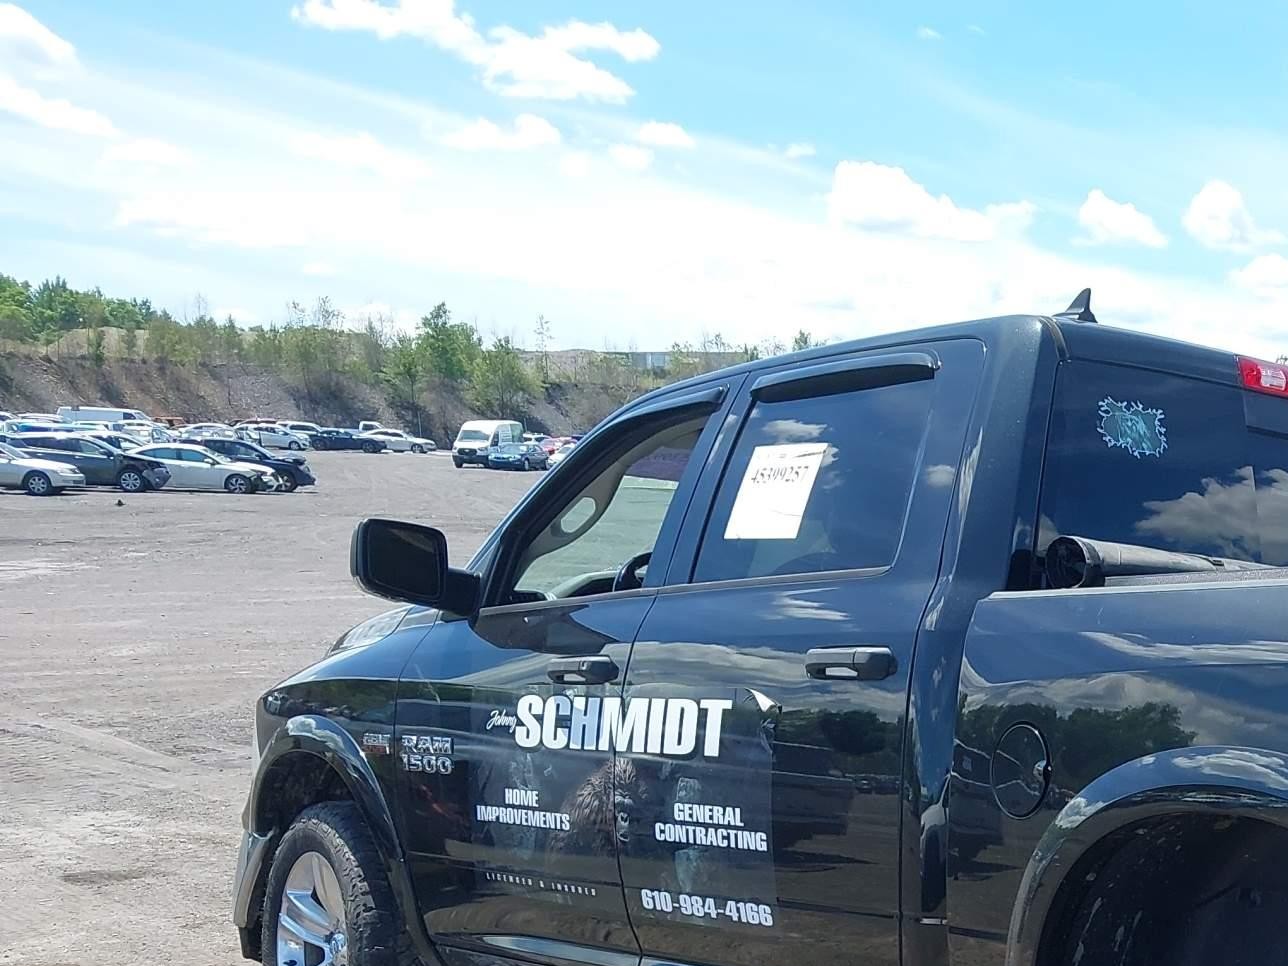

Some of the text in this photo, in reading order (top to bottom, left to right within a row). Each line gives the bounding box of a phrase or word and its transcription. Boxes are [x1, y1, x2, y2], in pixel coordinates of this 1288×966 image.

[486, 709, 516, 733] Johnny
[515, 695, 733, 757] SCHMIDT
[401, 735, 453, 755] RAM
[401, 753, 453, 775] 1500
[504, 788, 539, 808] HOME
[476, 804, 571, 831] IMPROVEMENTS
[673, 802, 745, 827] GENERAL
[655, 822, 768, 852] CONTRACTING
[641, 889, 774, 927] 610-984-4166
